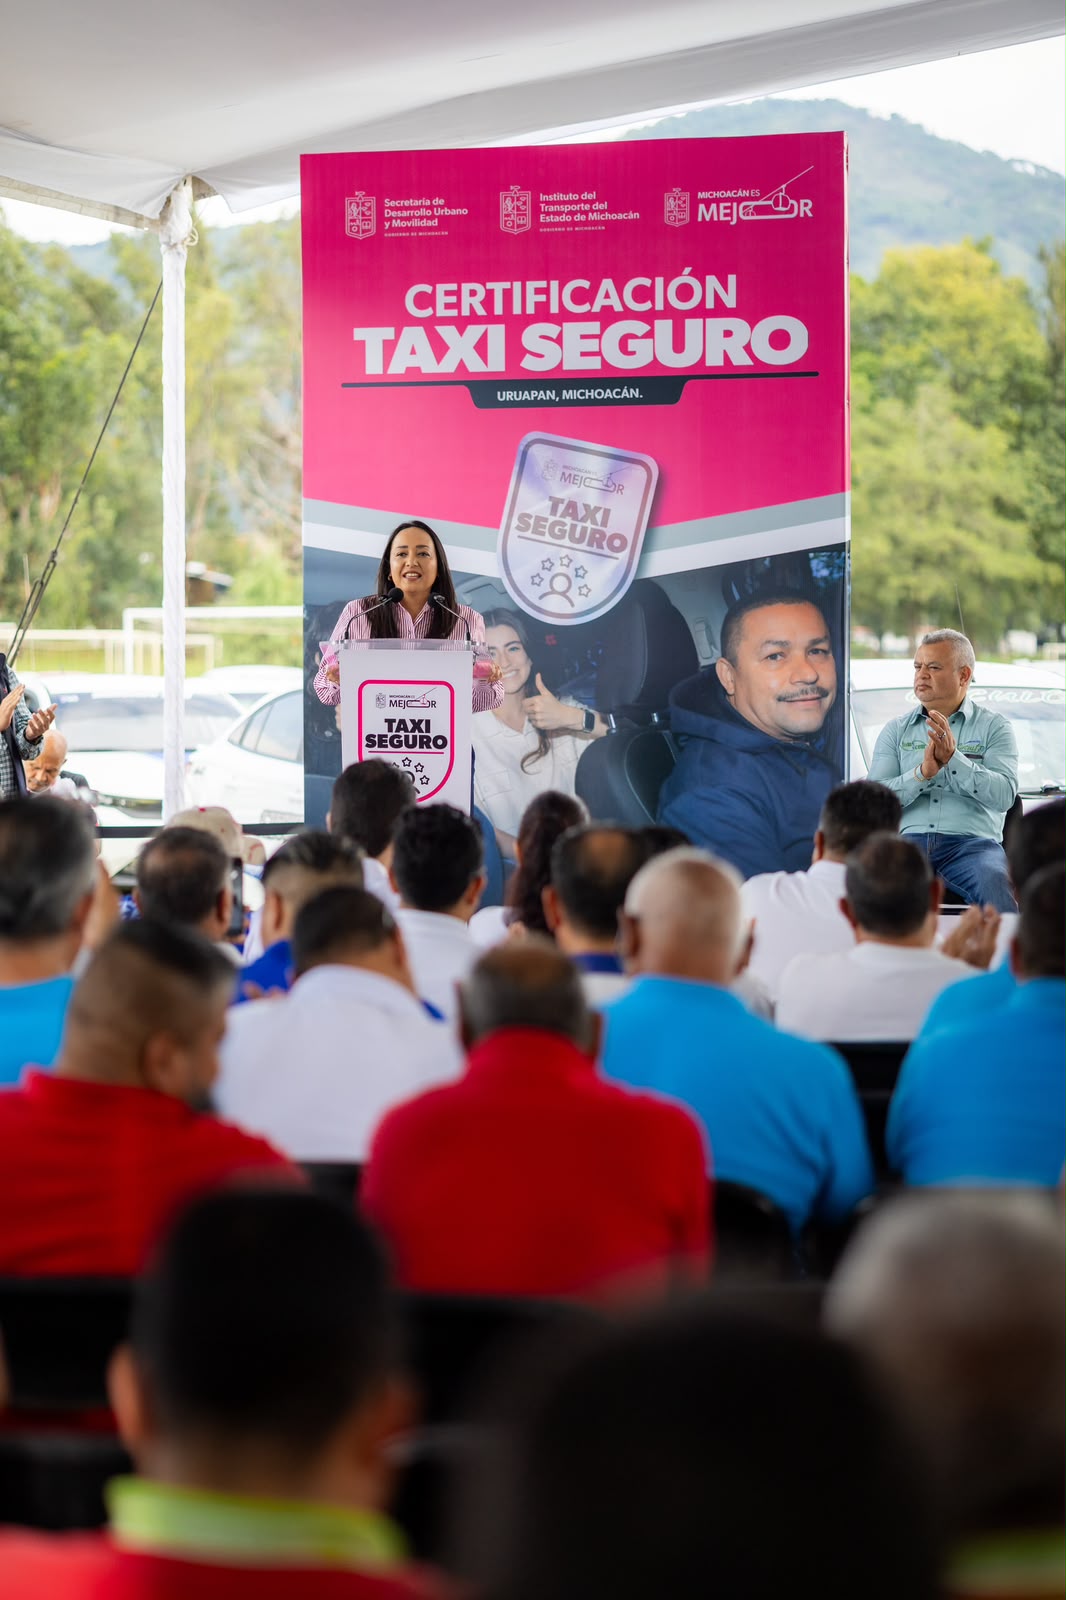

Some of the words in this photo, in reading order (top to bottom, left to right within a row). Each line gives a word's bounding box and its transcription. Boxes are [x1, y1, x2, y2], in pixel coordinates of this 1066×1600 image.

[539, 192, 579, 202] Instituto
[580, 191, 597, 200] del
[697, 189, 750, 199] MICHOACÁN
[384, 197, 431, 207] Secretaría
[432, 197, 445, 206] de
[539, 203, 590, 213] Transporte
[592, 201, 608, 210] del
[384, 208, 432, 218] Desarrollo
[433, 207, 469, 216] Urbano
[539, 213, 572, 223] Estado
[573, 213, 587, 221] de
[588, 211, 640, 221] Michoacán
[697, 198, 814, 226] MEJOR
[384, 221, 391, 230] y
[391, 218, 438, 228] Movilidad
[404, 267, 737, 319] CERTIFICACIÓN
[353, 323, 506, 376] TAXI
[519, 314, 809, 373] SEGURO
[496, 390, 560, 403] URUAPAN,
[561, 386, 643, 401] MICHOACÁN.
[548, 495, 612, 529] TAXI
[514, 512, 628, 554] SEGURO
[388, 700, 437, 709] MEJOR
[384, 718, 431, 734] TAXI
[364, 733, 448, 750] SEGURO
